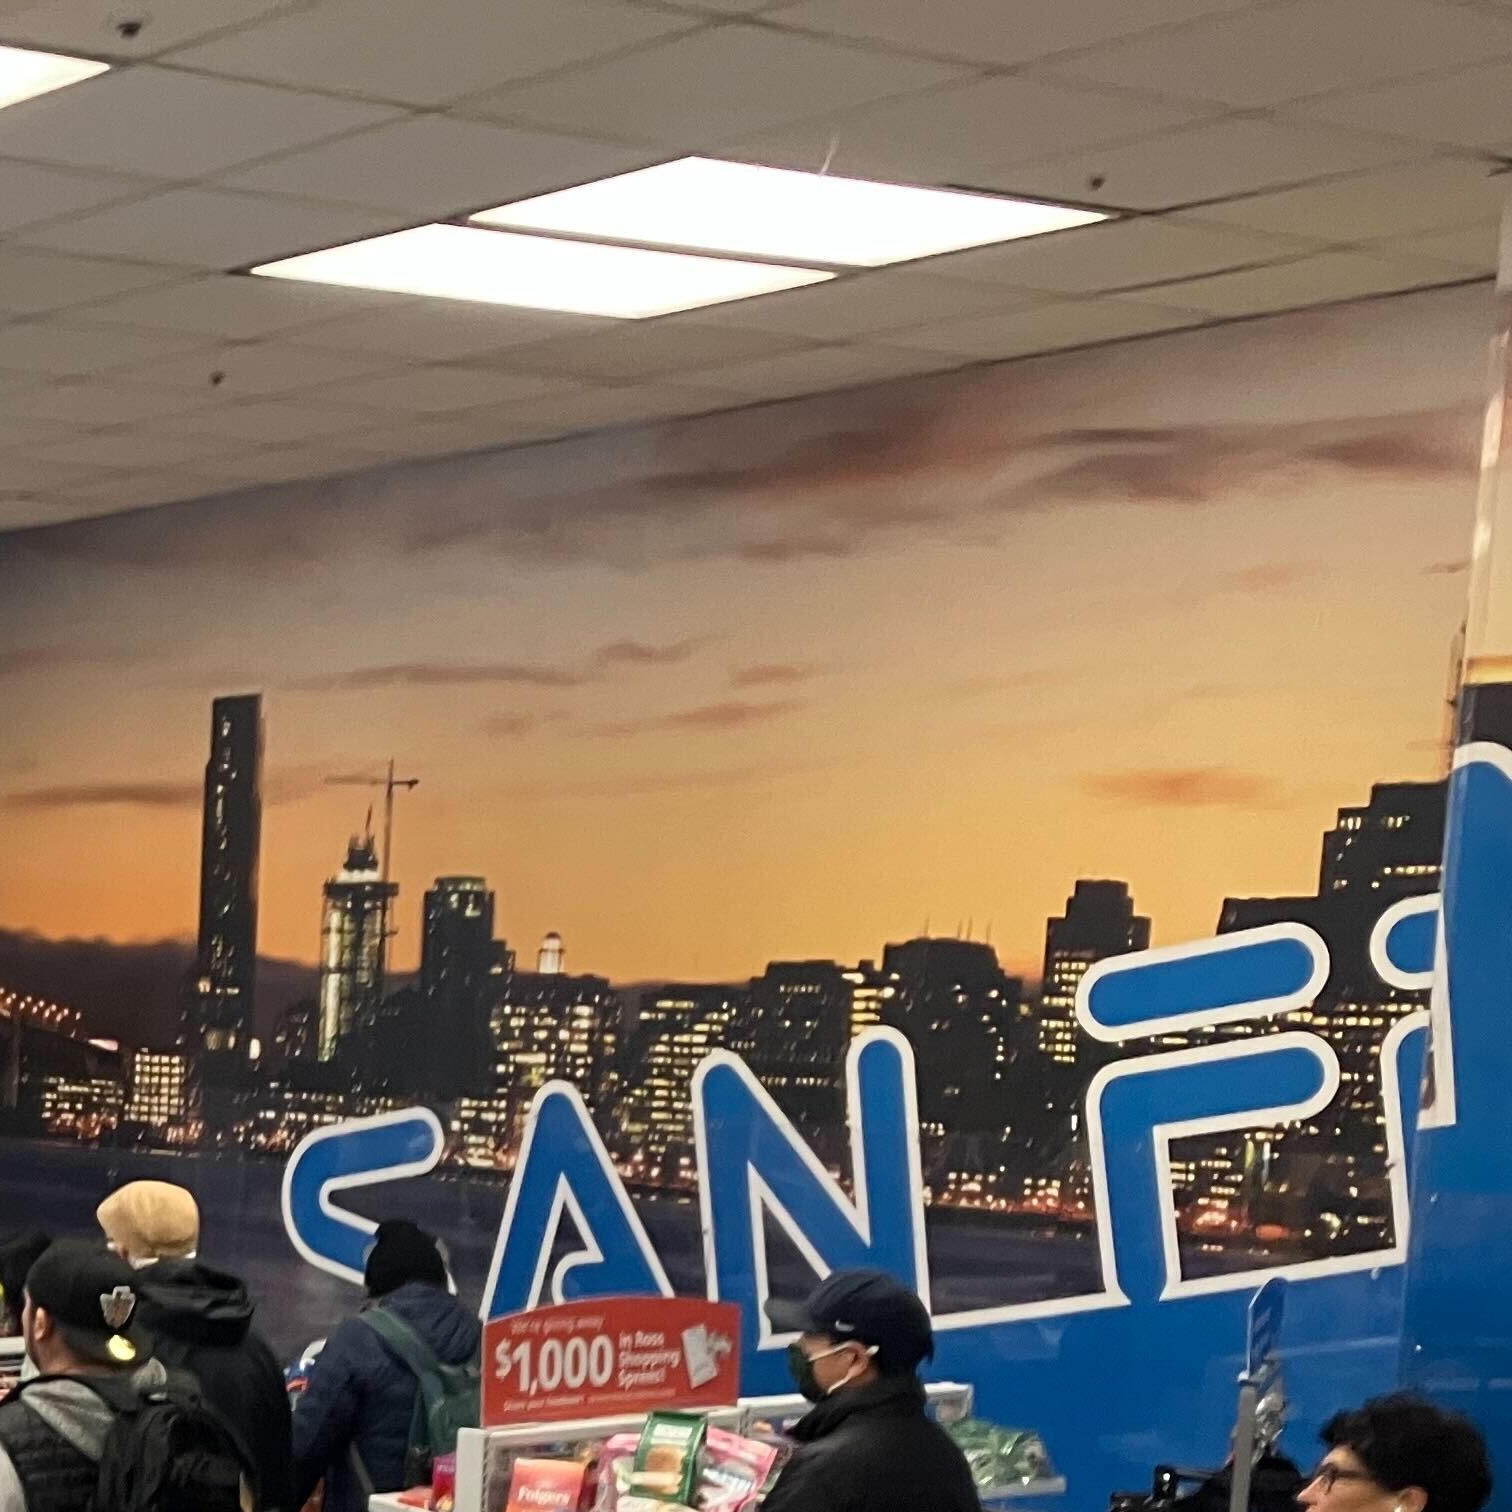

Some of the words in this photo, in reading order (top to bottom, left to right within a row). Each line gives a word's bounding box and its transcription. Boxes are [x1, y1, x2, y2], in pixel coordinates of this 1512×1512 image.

[283, 1025, 933, 1348] SAN
[618, 1350, 680, 1369] Shopping
[634, 1331, 665, 1348] Ross
[495, 1333, 614, 1397] $1,000
